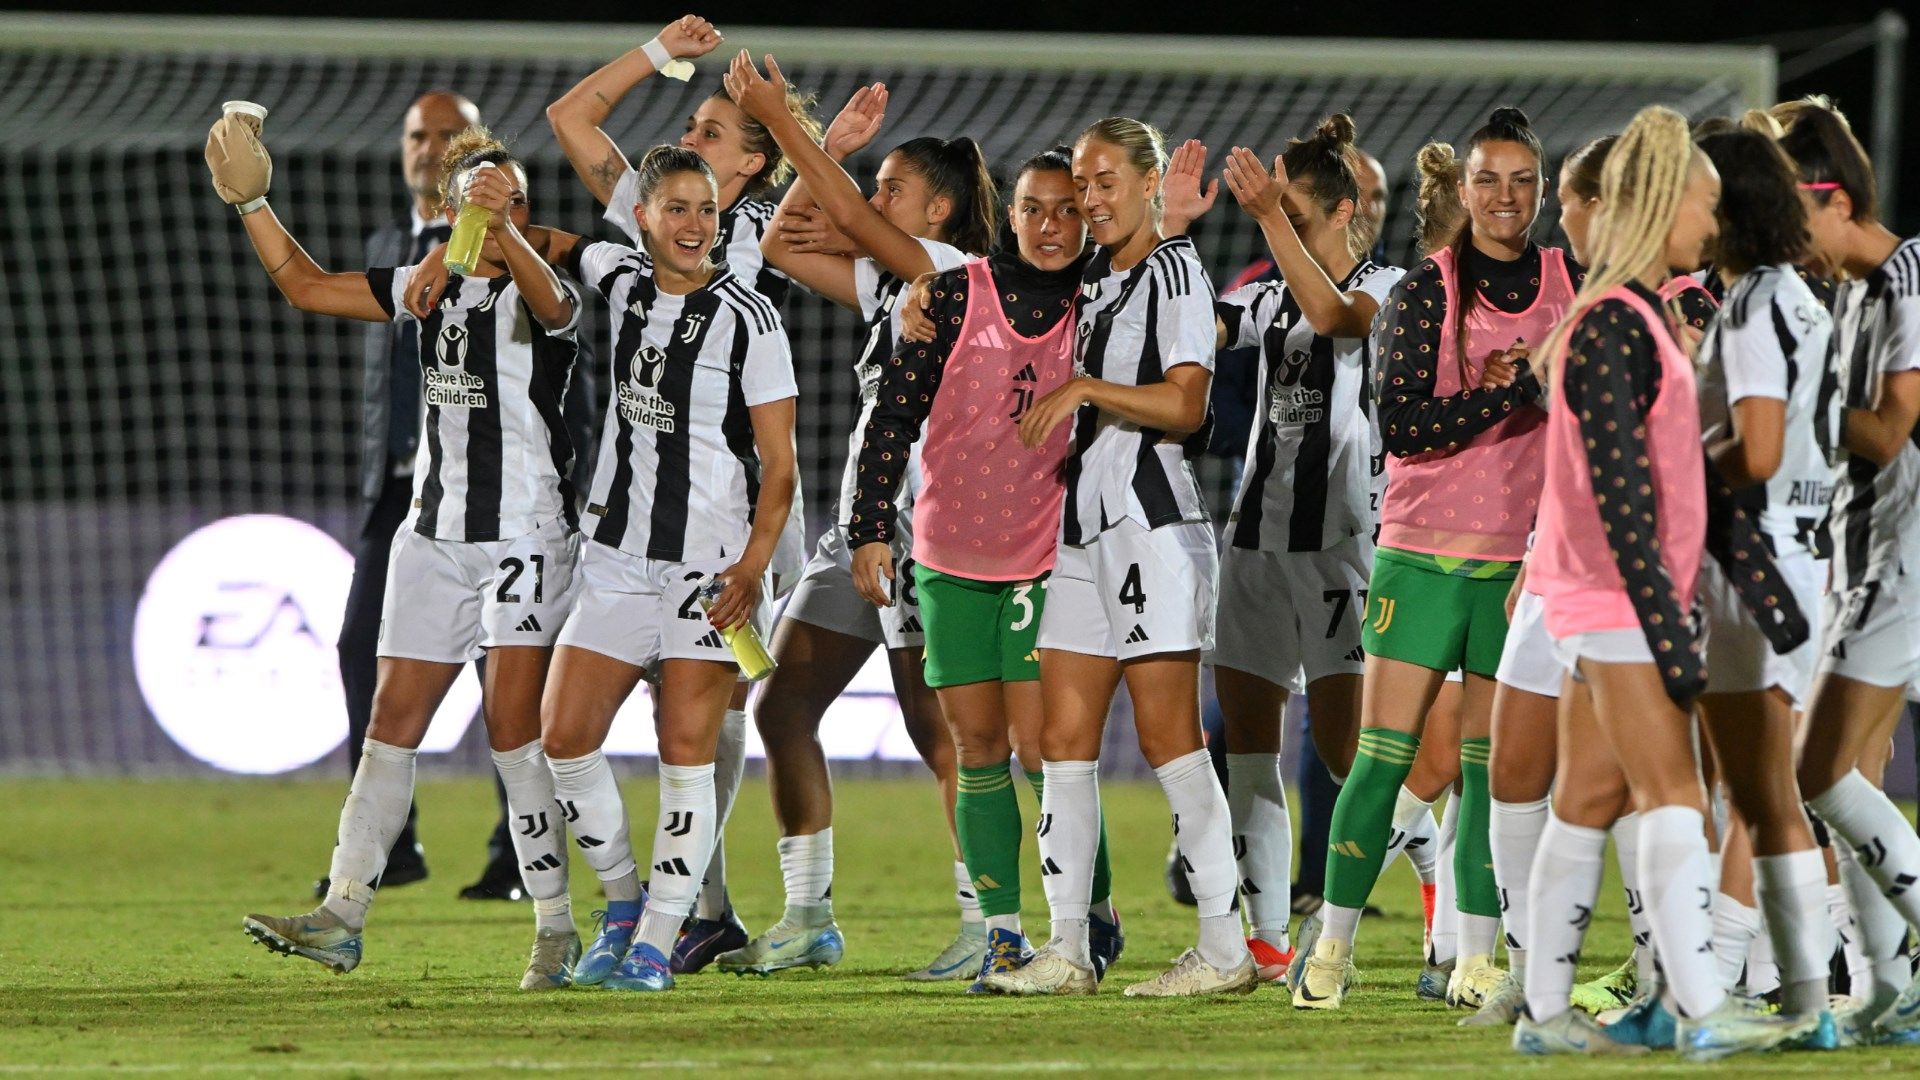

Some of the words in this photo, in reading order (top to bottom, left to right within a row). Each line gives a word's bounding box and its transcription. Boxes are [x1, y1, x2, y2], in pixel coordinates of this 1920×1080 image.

[427, 368, 457, 386] Save
[459, 372, 482, 387] the
[427, 388, 486, 406] Children
[1293, 389, 1322, 404] the
[619, 383, 647, 405] Save
[649, 396, 674, 414] the
[620, 402, 673, 431] Children
[497, 555, 544, 604] 21
[678, 571, 721, 621] 2
[1119, 563, 1146, 614] 4
[197, 581, 325, 648] EA
[1010, 582, 1049, 631] 3
